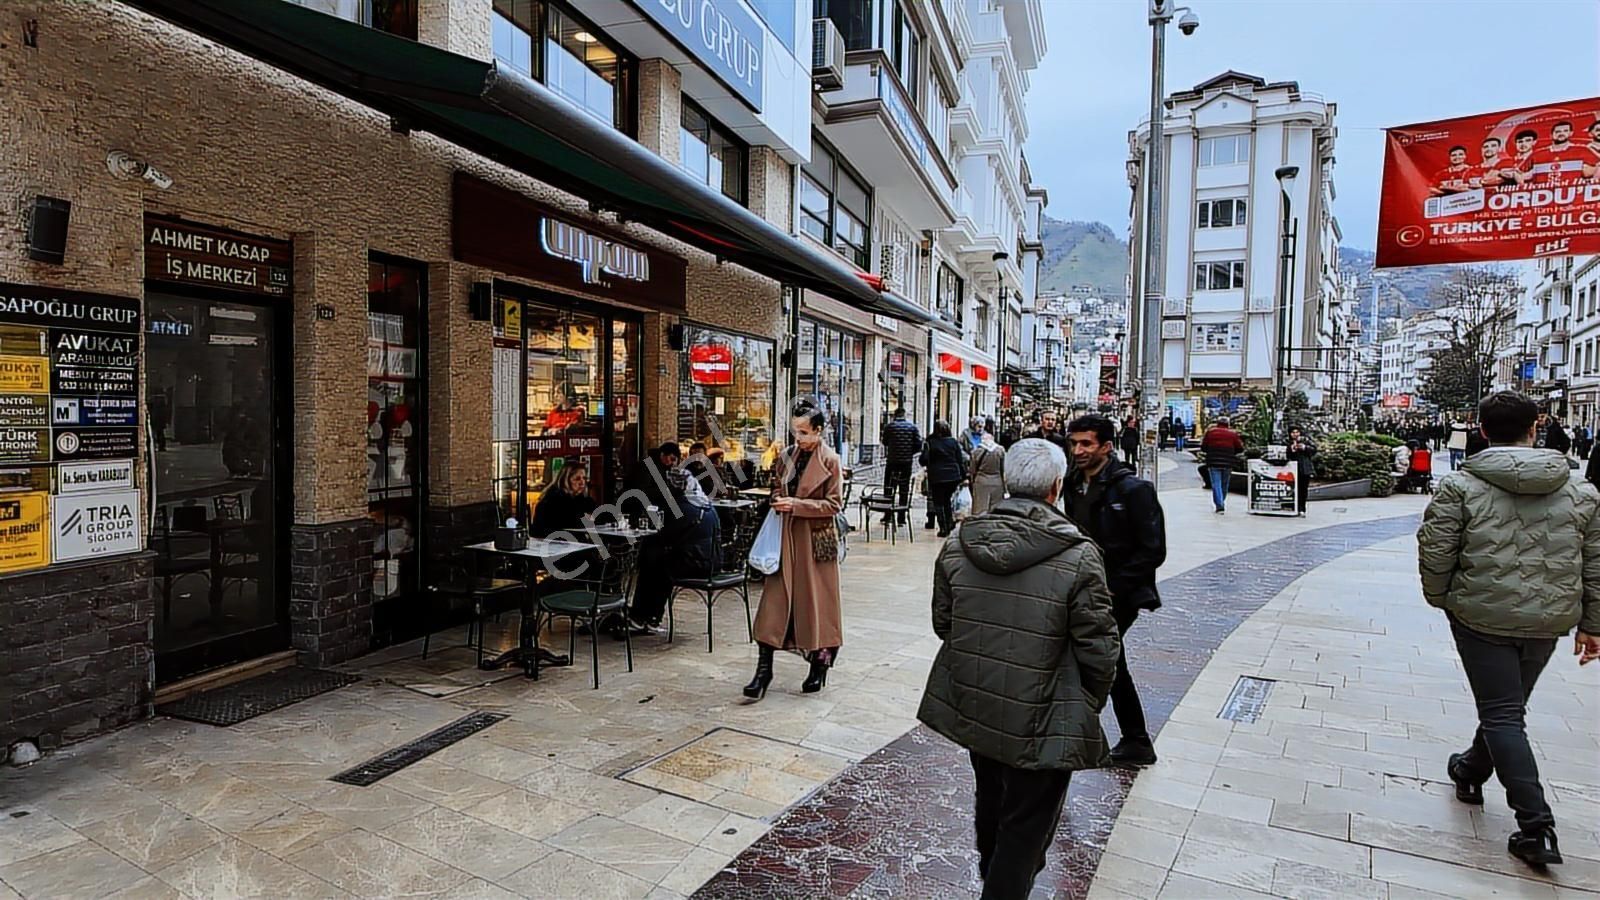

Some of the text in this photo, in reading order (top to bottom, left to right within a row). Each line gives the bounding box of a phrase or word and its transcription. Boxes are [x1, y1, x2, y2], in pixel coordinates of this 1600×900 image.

[659, 0, 759, 87] U GRUP
[1430, 217, 1522, 236] TÜRKİYE
[1536, 211, 1600, 229] BULG
[150, 227, 270, 262] AHMET KASAP
[1534, 238, 1571, 254] EHF
[166, 253, 257, 286] İŞ MERKEZİ
[89, 306, 138, 324] GRUP
[57, 333, 133, 353] AVUKAT
[59, 353, 133, 367] ARABULUCU
[569, 438, 600, 453] unpam
[86, 504, 132, 521] TRIA
[86, 520, 134, 534] GROUP
[87, 531, 133, 544] SİGORTA
